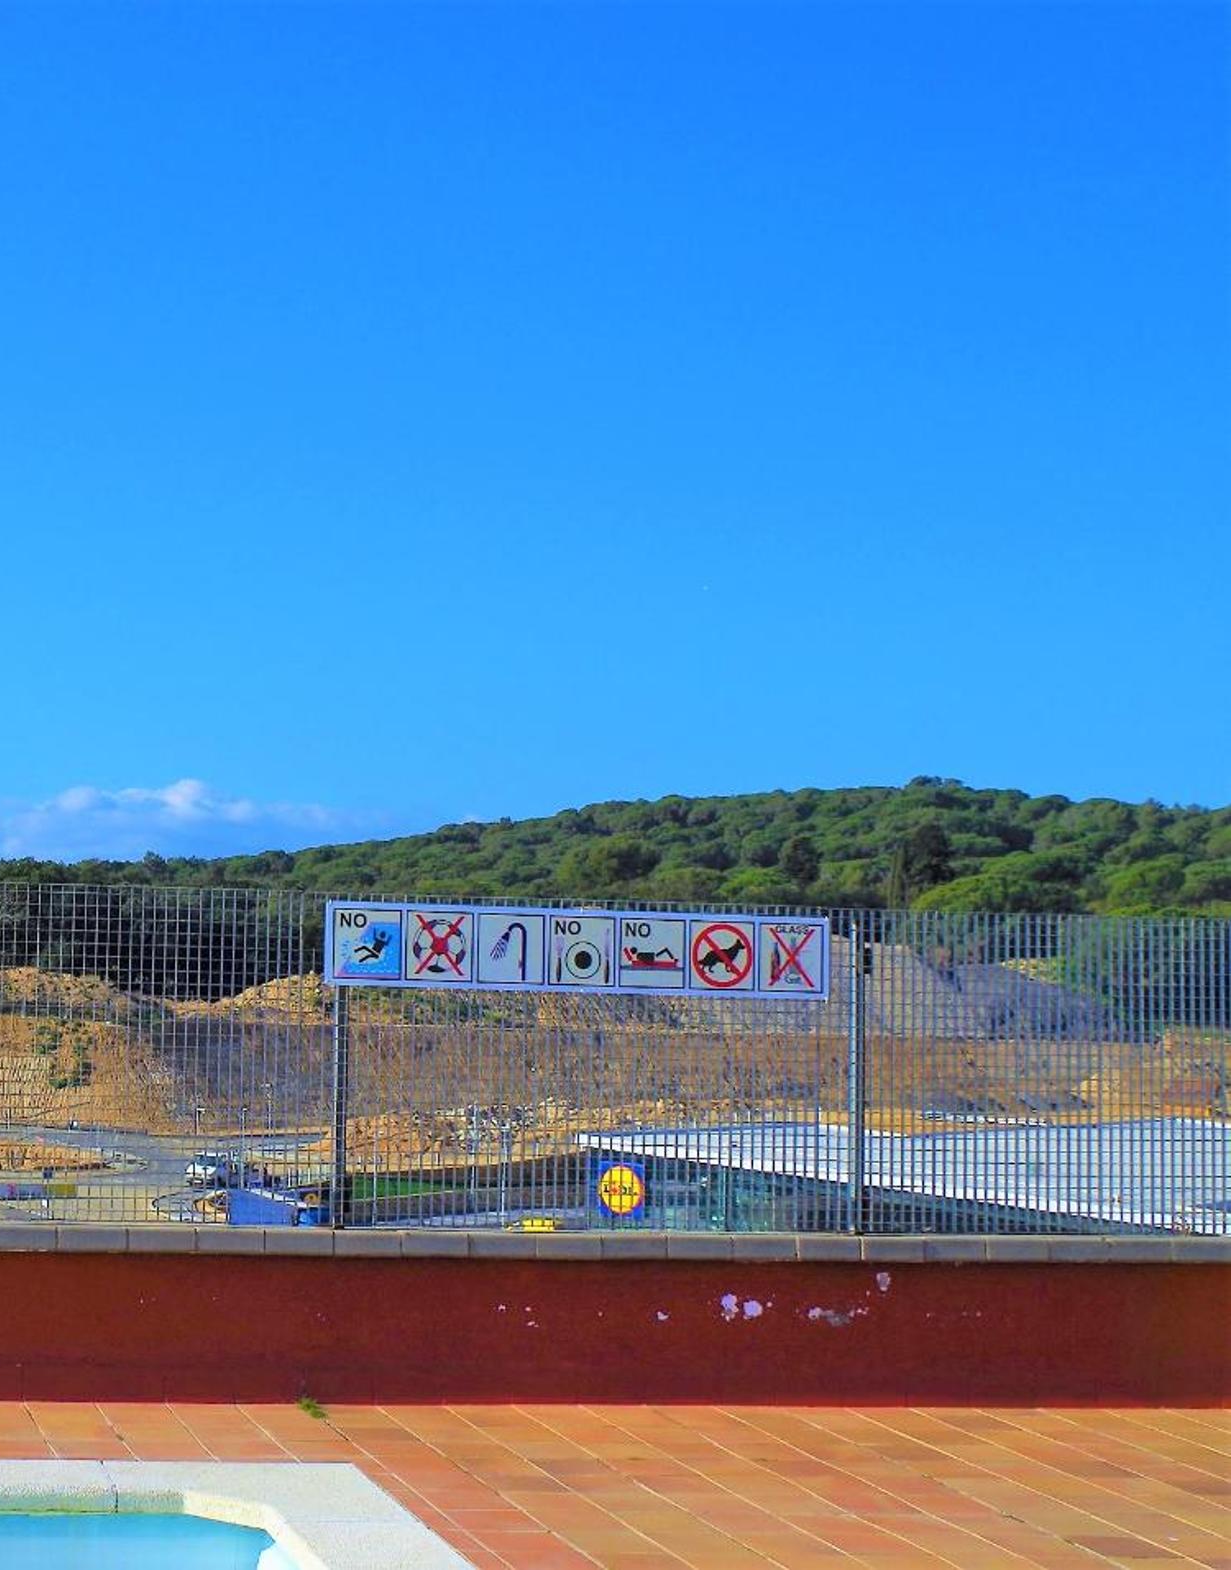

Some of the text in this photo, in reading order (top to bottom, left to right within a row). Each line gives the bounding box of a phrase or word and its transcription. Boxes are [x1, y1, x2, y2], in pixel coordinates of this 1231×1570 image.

[340, 912, 367, 928] NO
[554, 919, 582, 936] NO
[624, 921, 651, 938] NO
